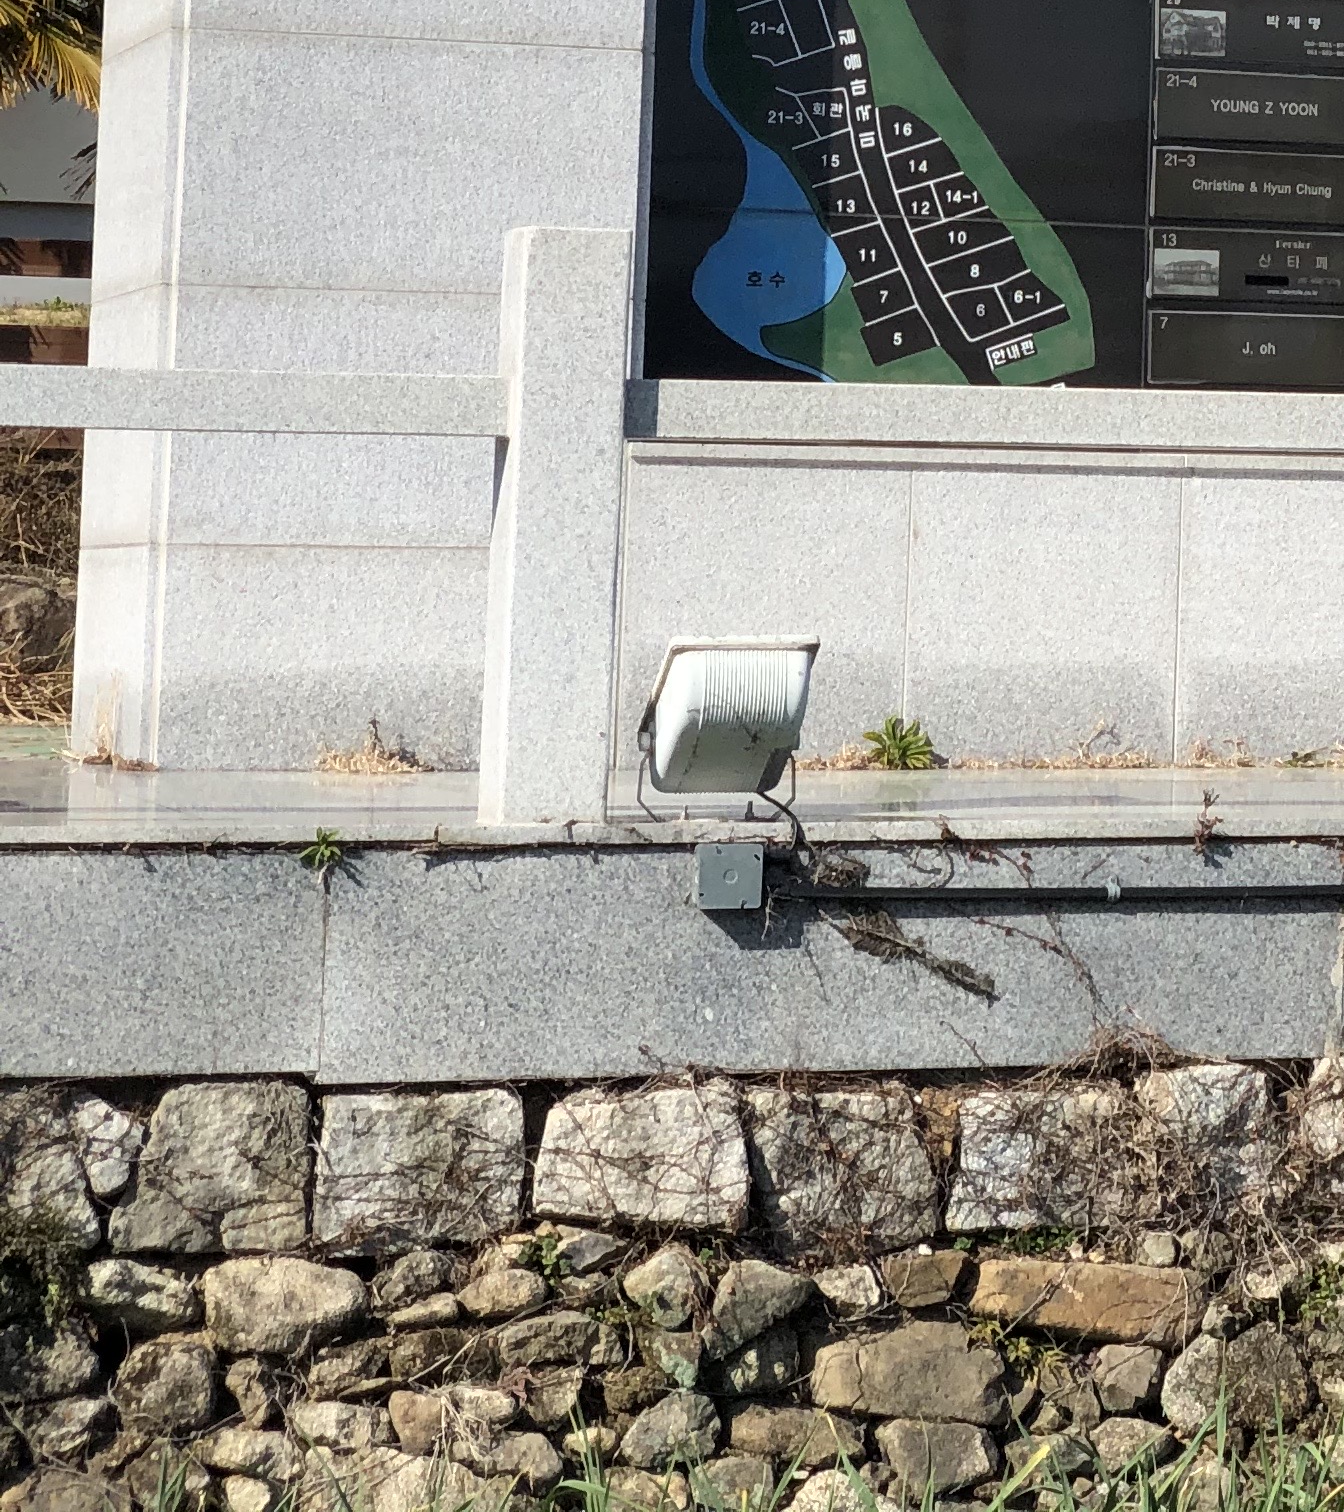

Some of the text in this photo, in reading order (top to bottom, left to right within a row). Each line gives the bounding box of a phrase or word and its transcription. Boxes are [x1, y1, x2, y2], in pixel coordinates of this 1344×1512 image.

[751, 22, 785, 35] 21-4
[1167, 74, 1197, 87] 21-4
[812, 102, 843, 118] 회관
[1211, 99, 1318, 116] YOUNG Z YOON
[768, 110, 803, 125] 21-3
[894, 123, 912, 136] 16
[822, 154, 839, 167] 15
[909, 160, 927, 172] 14
[1164, 153, 1196, 168] 21-3
[1193, 179, 1244, 192] Christine
[1263, 182, 1291, 196] Hyun
[1296, 184, 1331, 198] Chung
[946, 190, 977, 203] 14-1
[837, 200, 855, 213] 13
[912, 201, 930, 214] 12
[949, 231, 966, 244] 10
[1162, 234, 1176, 246] 13
[859, 249, 875, 262] 11
[746, 271, 785, 288] 호수
[1160, 317, 1168, 329] 7
[992, 338, 1035, 365] 안내판
[1243, 342, 1275, 354] J. oh
